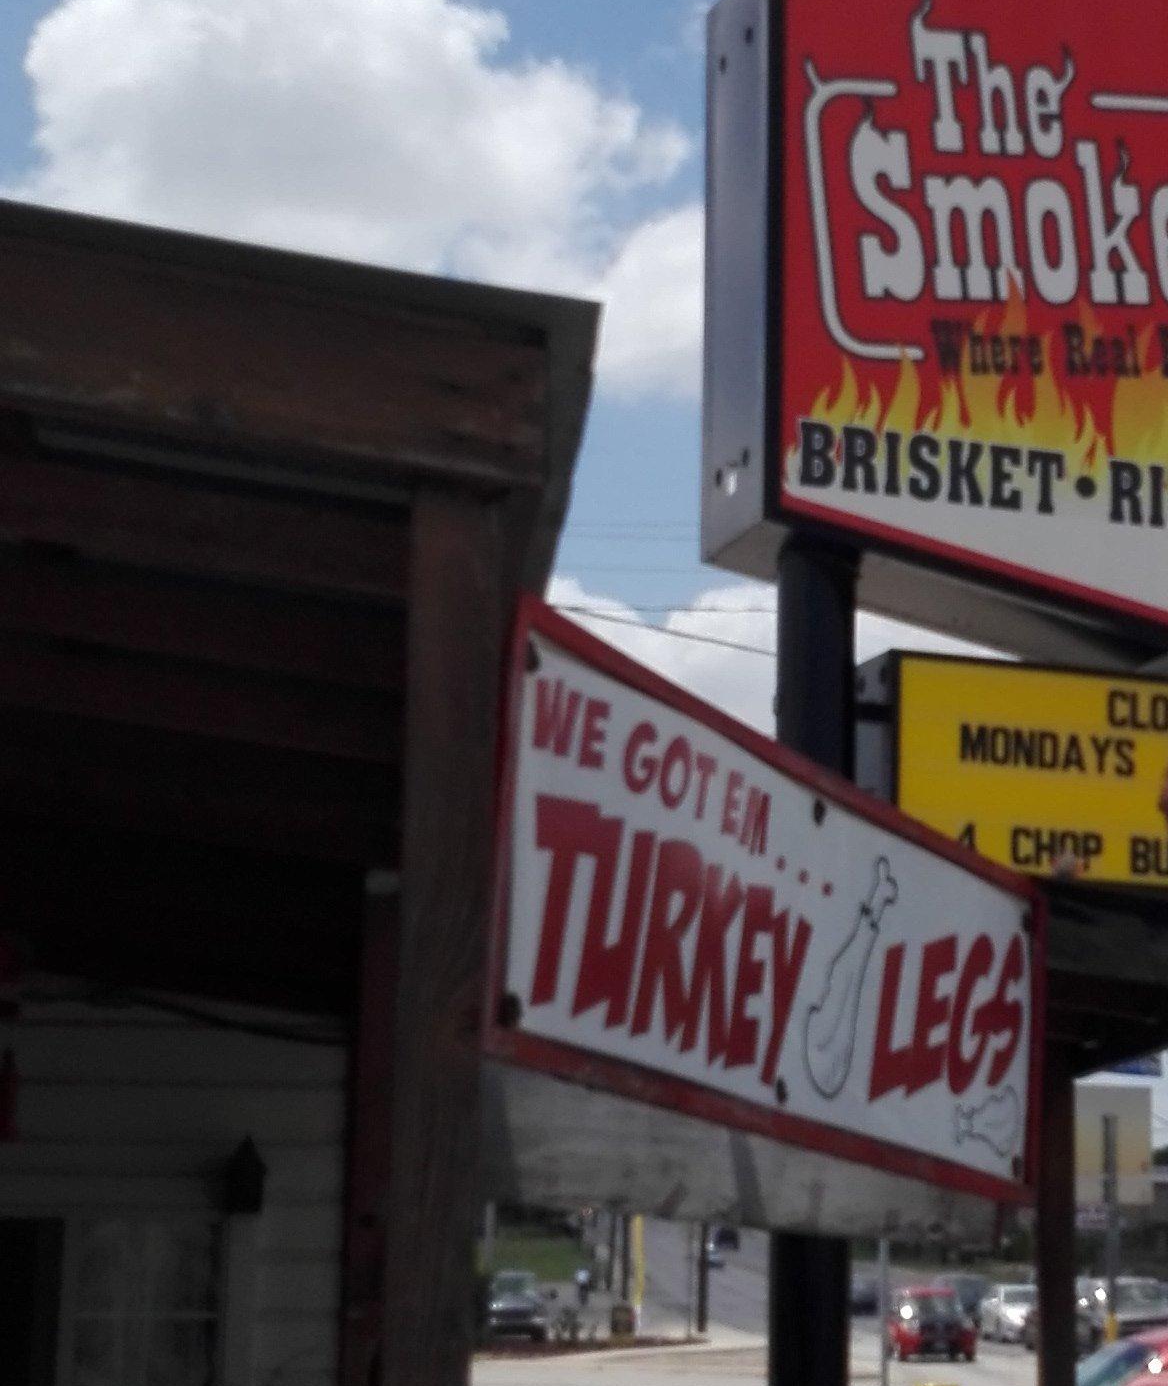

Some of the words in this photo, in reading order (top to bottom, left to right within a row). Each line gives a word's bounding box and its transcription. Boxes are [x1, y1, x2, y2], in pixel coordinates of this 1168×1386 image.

[909, 9, 1074, 159] The
[932, 319, 1043, 377] Where
[1062, 319, 1142, 378] Real
[798, 420, 1066, 516] BRISKET
[530, 677, 611, 769] WE
[622, 719, 717, 821] GOT
[959, 723, 1135, 777] MONDAYS
[1011, 825, 1104, 872] CHOP
[528, 792, 813, 1088] TURKEY
[867, 930, 1026, 1105] LEGS
